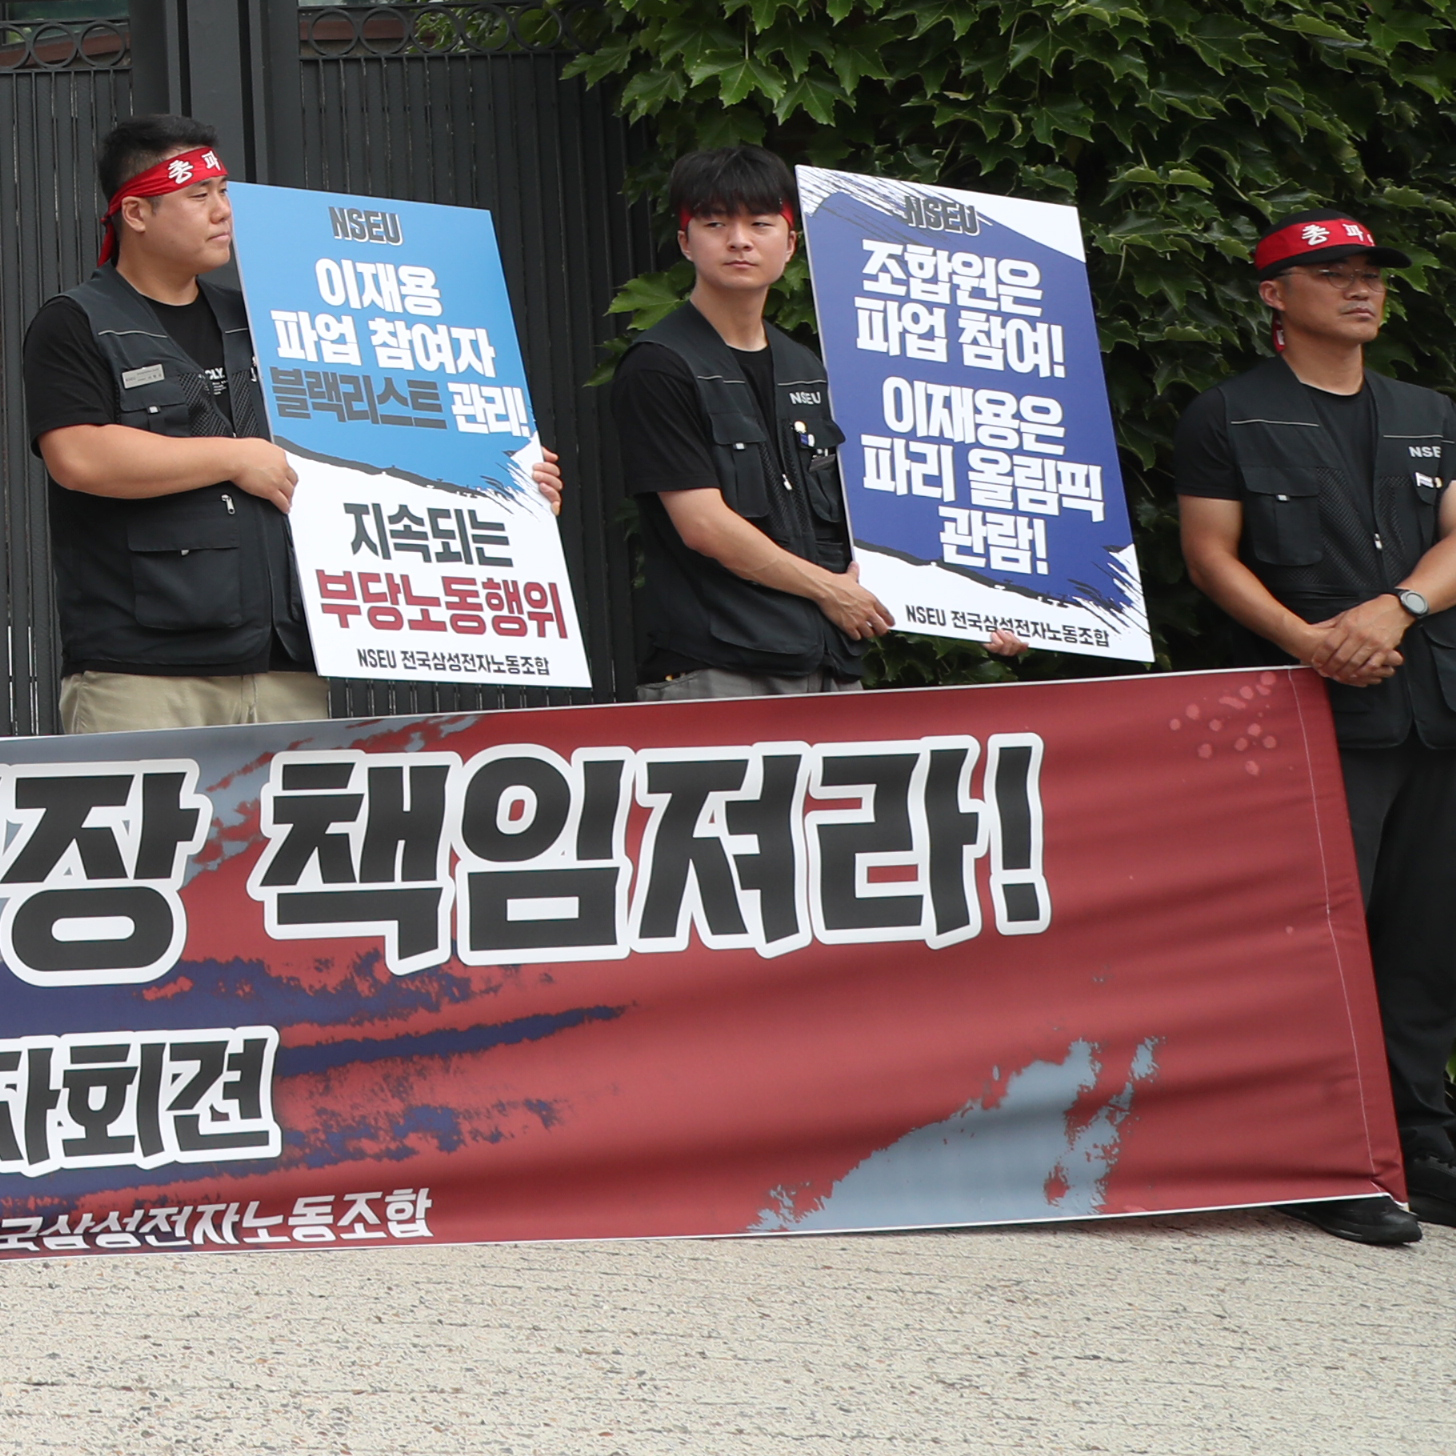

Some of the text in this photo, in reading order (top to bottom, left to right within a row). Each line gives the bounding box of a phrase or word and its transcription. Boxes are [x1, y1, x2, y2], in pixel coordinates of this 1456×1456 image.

[329, 206, 403, 245] NSEU
[904, 196, 981, 235] NSEU
[314, 258, 441, 317] 이재용
[861, 238, 1043, 317] 조합원은
[270, 310, 496, 378] 파업 참여자
[854, 296, 1065, 378] 파업 참여!
[270, 367, 531, 438] 블랙리스트 관리!
[882, 376, 1065, 455] 이재용은
[861, 434, 1104, 522] 파리 올림픽
[344, 502, 513, 567] 지속되는
[938, 505, 1049, 575] 관람!
[316, 569, 568, 639] 부당노동행위
[905, 605, 1110, 647] NSEU 전국삼성전자노동조합
[358, 649, 549, 675] NSEU 전국삼성전자노동조합
